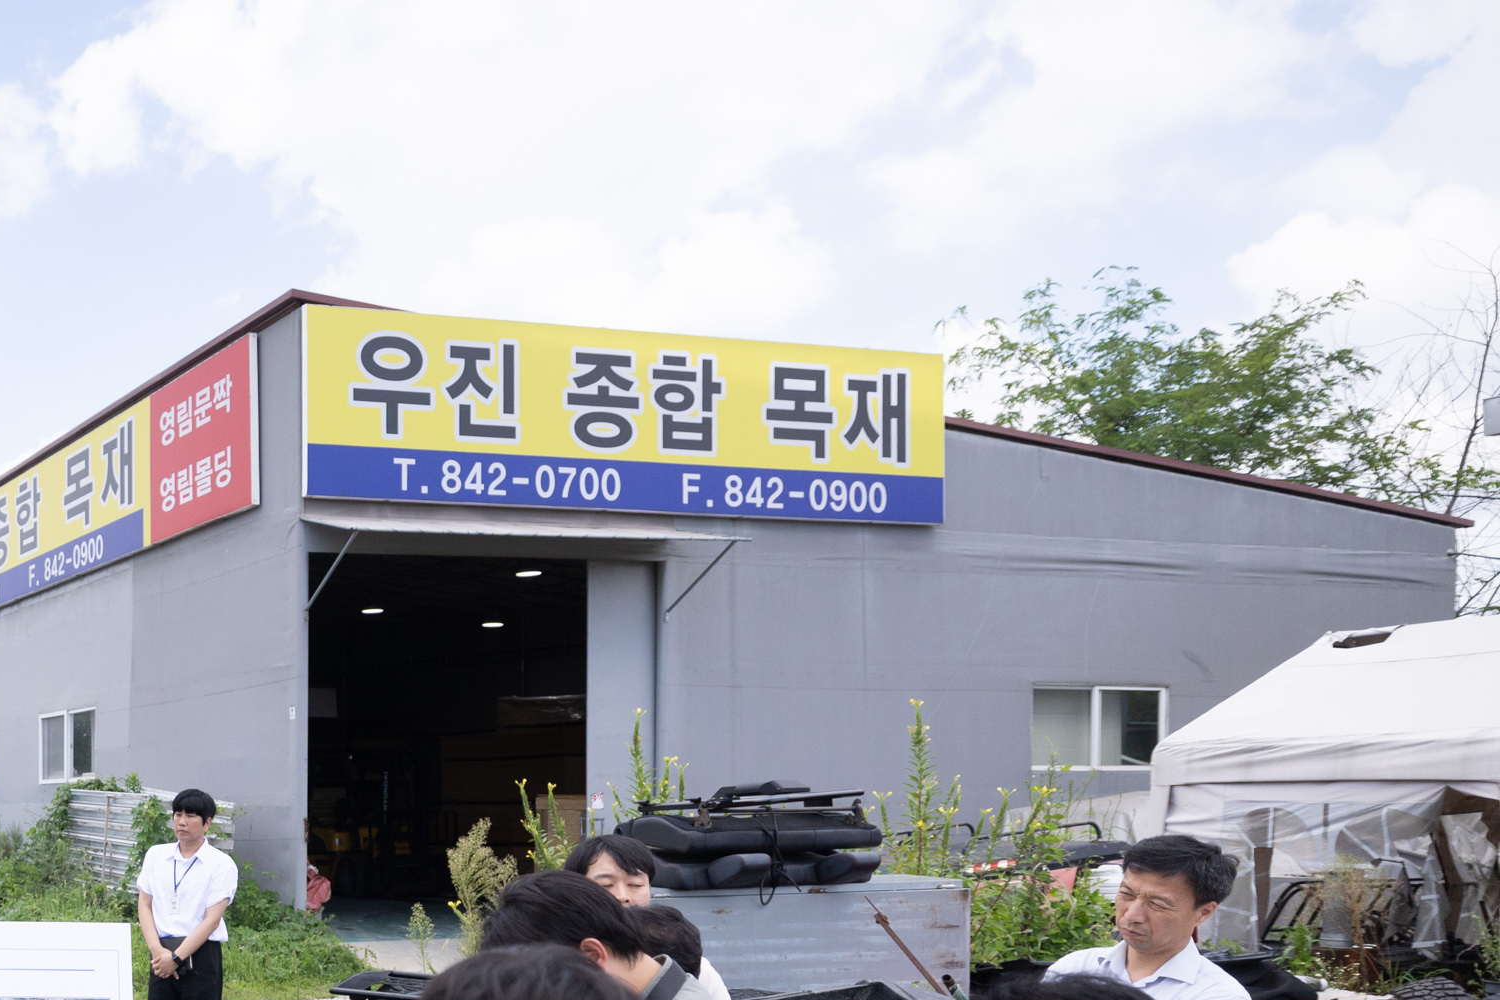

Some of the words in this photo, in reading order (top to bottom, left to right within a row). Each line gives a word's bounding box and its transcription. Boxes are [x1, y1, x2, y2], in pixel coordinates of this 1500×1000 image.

[158, 373, 233, 447] 영림문짝
[352, 334, 518, 439] 우진
[566, 351, 721, 451] 종합
[765, 365, 908, 463] 목재
[63, 420, 134, 527] 목재
[159, 445, 233, 513] 영림몰딩
[393, 457, 429, 495] T.
[440, 459, 621, 502] 842-0700
[681, 472, 714, 508] F.
[724, 474, 888, 514] 842-0900
[28, 564, 40, 588] F.
[44, 533, 104, 583] 842-0900
